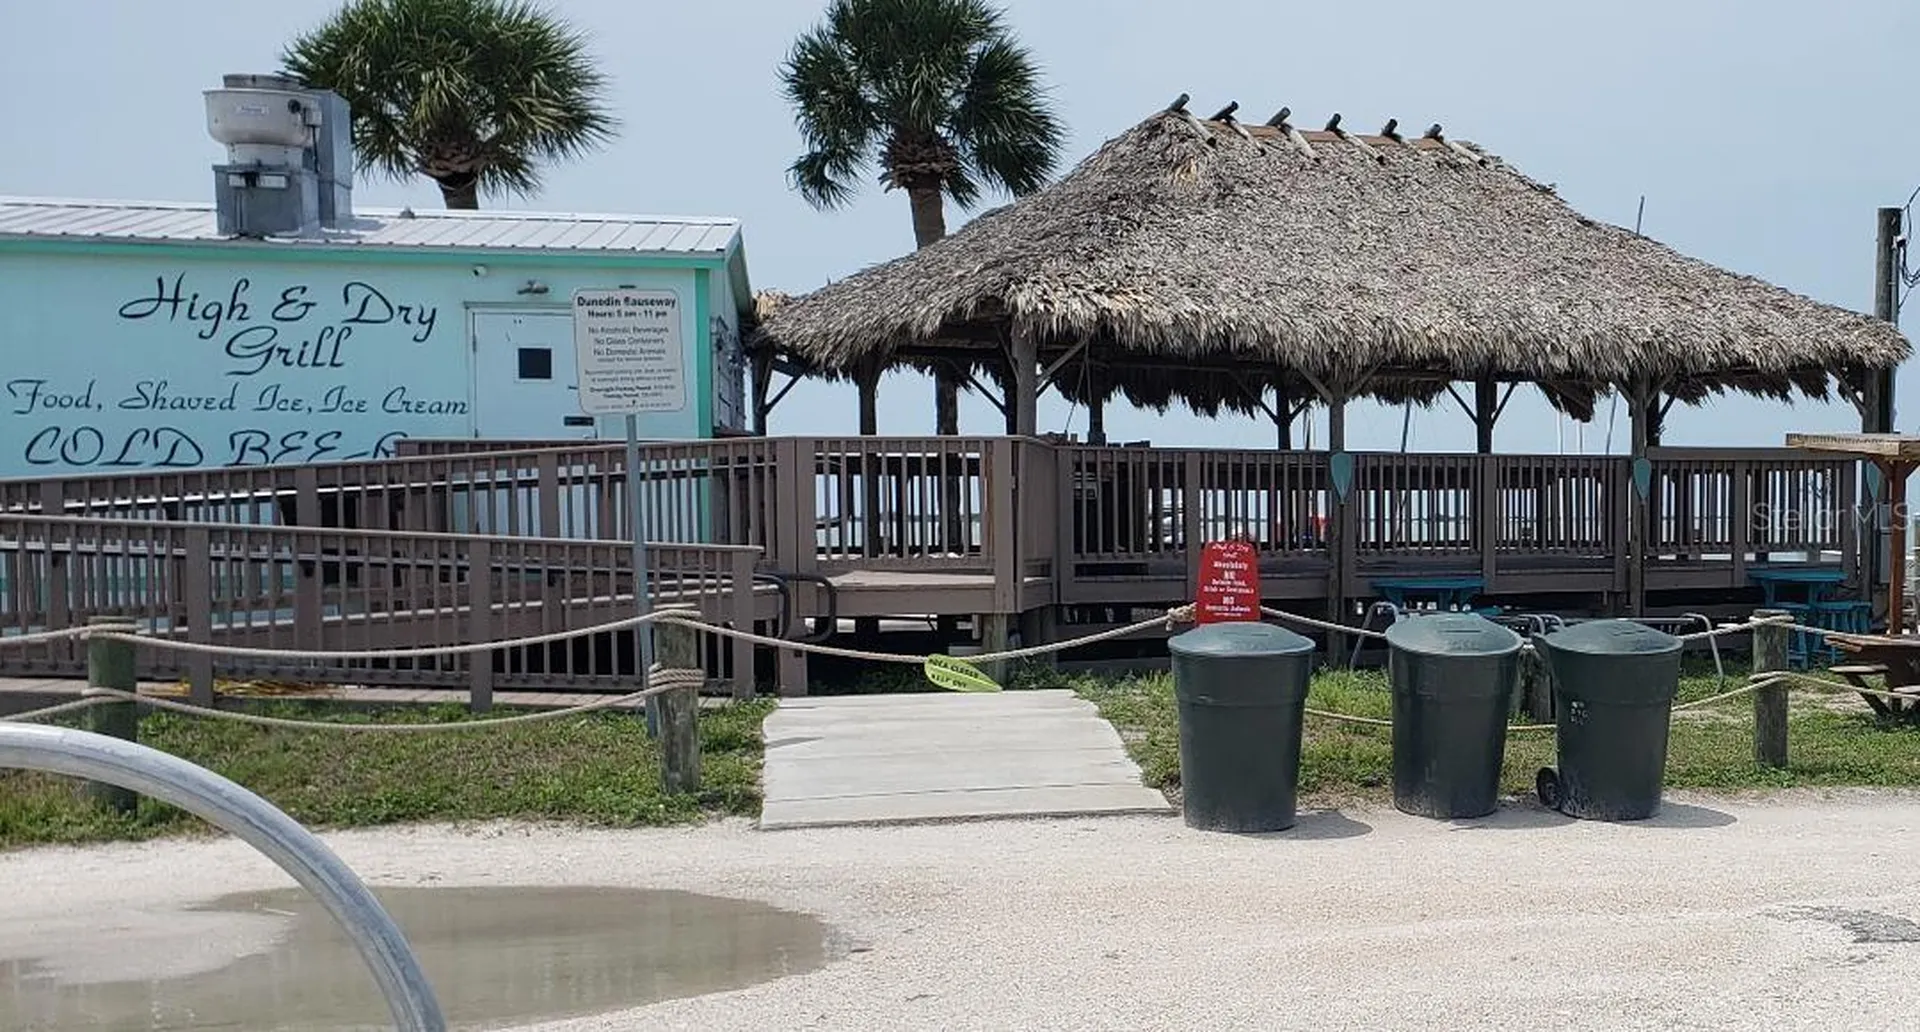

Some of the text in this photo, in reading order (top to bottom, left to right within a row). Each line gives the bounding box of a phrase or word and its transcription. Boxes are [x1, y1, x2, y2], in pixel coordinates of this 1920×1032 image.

[118, 271, 437, 342] High & Dry
[577, 296, 676, 308] Dunedin Causeway
[588, 310, 615, 318] Hours:
[643, 310, 653, 318] 11
[225, 326, 353, 376] Grill
[6, 379, 103, 415] Food,
[118, 380, 239, 412] Shaved
[318, 385, 368, 414] Ice
[381, 386, 469, 416] Cream
[25, 426, 204, 467] COLD
